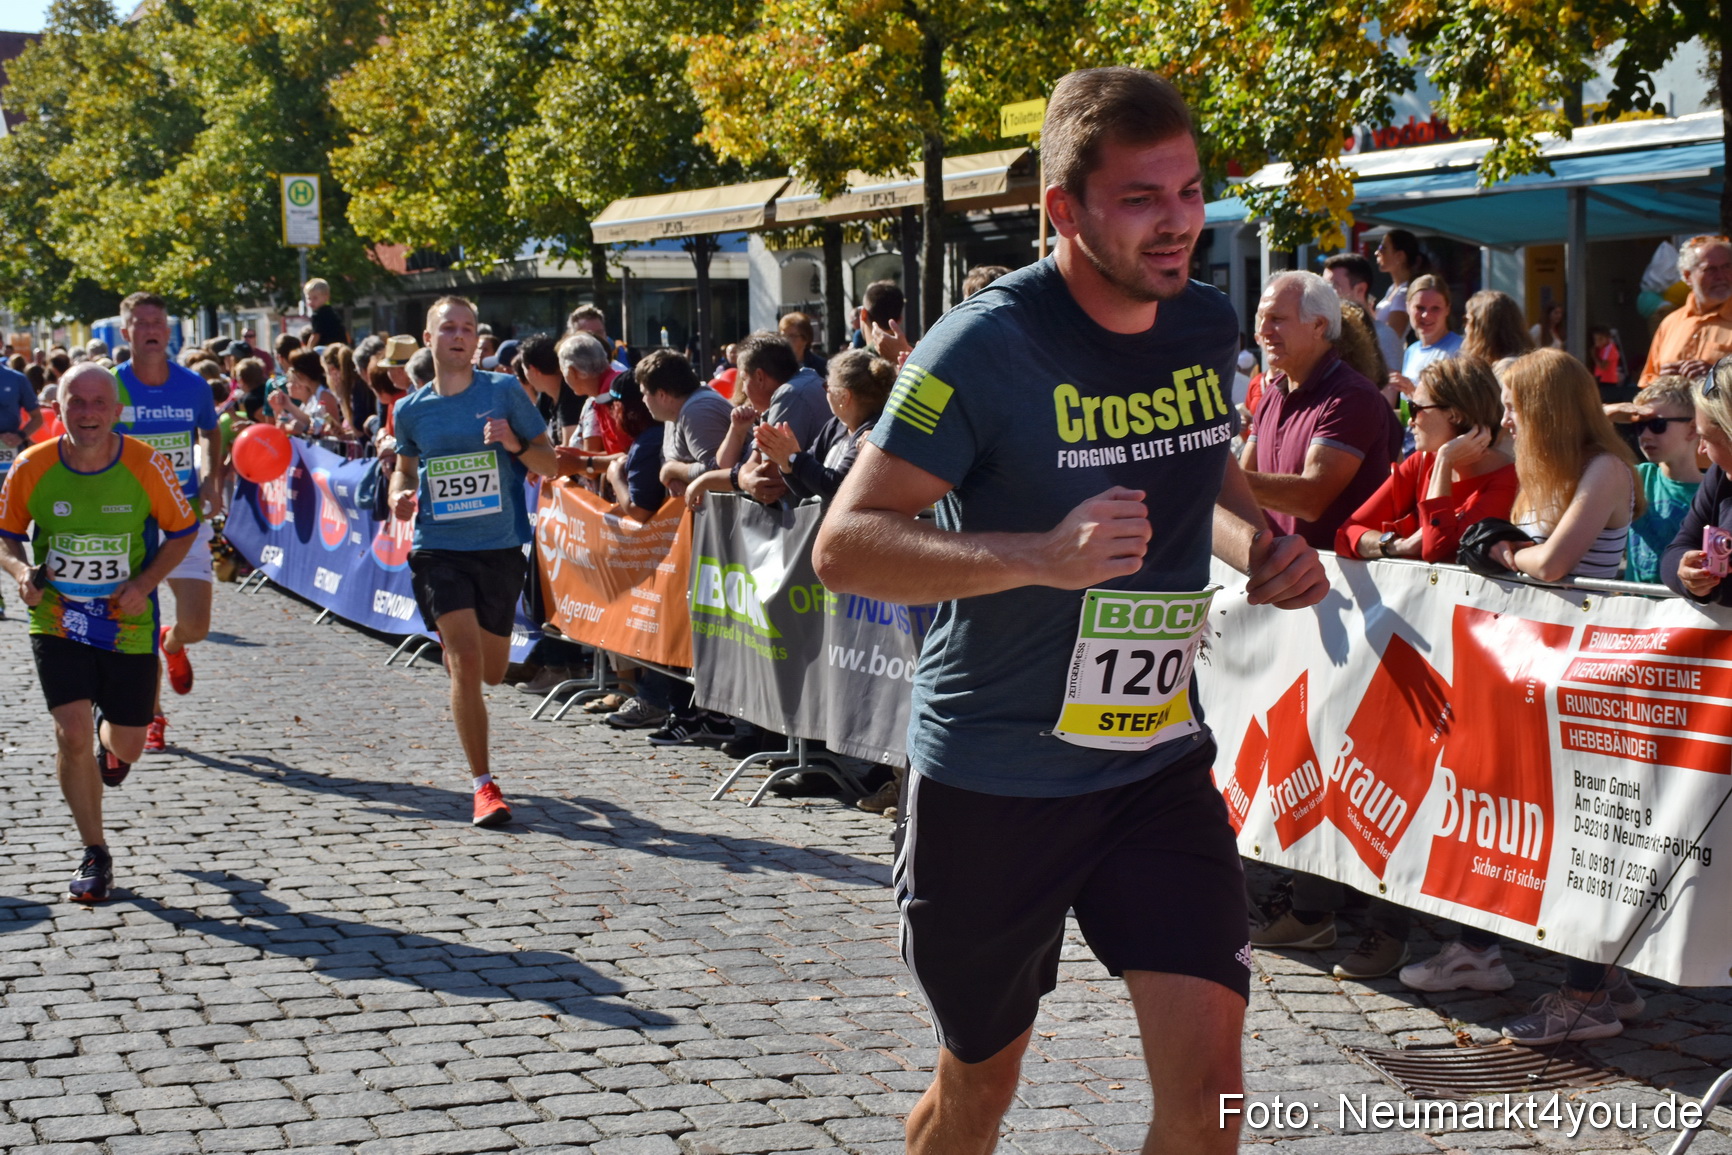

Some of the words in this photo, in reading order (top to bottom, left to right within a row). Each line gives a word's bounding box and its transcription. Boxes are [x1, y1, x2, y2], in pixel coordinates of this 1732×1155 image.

[1010, 111, 1042, 127] Toiletten
[136, 405, 194, 422] Freitag
[1053, 364, 1228, 443] CrossFit
[142, 434, 187, 449] OCK
[1057, 446, 1127, 468] FORGING
[1131, 437, 1174, 462] ELITE
[1178, 421, 1232, 452] FITNESS
[432, 454, 491, 474] BOCK
[437, 474, 490, 498] 2597
[447, 499, 485, 512] DANIEL
[56, 536, 123, 554] BOCK
[54, 557, 119, 580] 2733
[560, 594, 605, 624] Agentur
[1097, 600, 1209, 631] BOCK
[1589, 631, 1670, 650] BINDESTRICKE
[1572, 662, 1701, 690] VERZURRSYSTEME
[1098, 704, 1172, 732] STEFAN
[1565, 694, 1687, 726] RUNDSCHLINGEN
[1430, 726, 1442, 744] Seit
[1569, 729, 1658, 760] HEBEBÄNDER
[1266, 759, 1320, 823] Braun
[1330, 732, 1407, 839] Braun
[1574, 770, 1606, 792] Braun
[1609, 776, 1641, 800] GmbH
[1293, 804, 1310, 821] Sicher
[1308, 799, 1316, 811] ist
[1434, 766, 1544, 861] Braun
[1574, 793, 1591, 812] Am
[1594, 797, 1641, 829] Grünberg
[1645, 808, 1652, 826] 8
[1347, 806, 1363, 833] Sicher
[1362, 827, 1371, 841] ist
[1371, 836, 1392, 860] sicher
[1574, 815, 1609, 842] D-92318
[1612, 825, 1712, 867] Neumarkt-Pölling
[1471, 856, 1502, 879] Sicher
[1503, 865, 1516, 883] ist
[1517, 869, 1546, 892] sicher
[1571, 847, 1586, 868] Tel.
[1588, 853, 1615, 876] 09181
[1618, 860, 1625, 878] /
[1626, 862, 1657, 887] 2307-0
[1567, 870, 1584, 892] Fax
[1586, 876, 1613, 899] 09181
[1615, 883, 1622, 901] /
[1622, 886, 1667, 911] 2307-70
